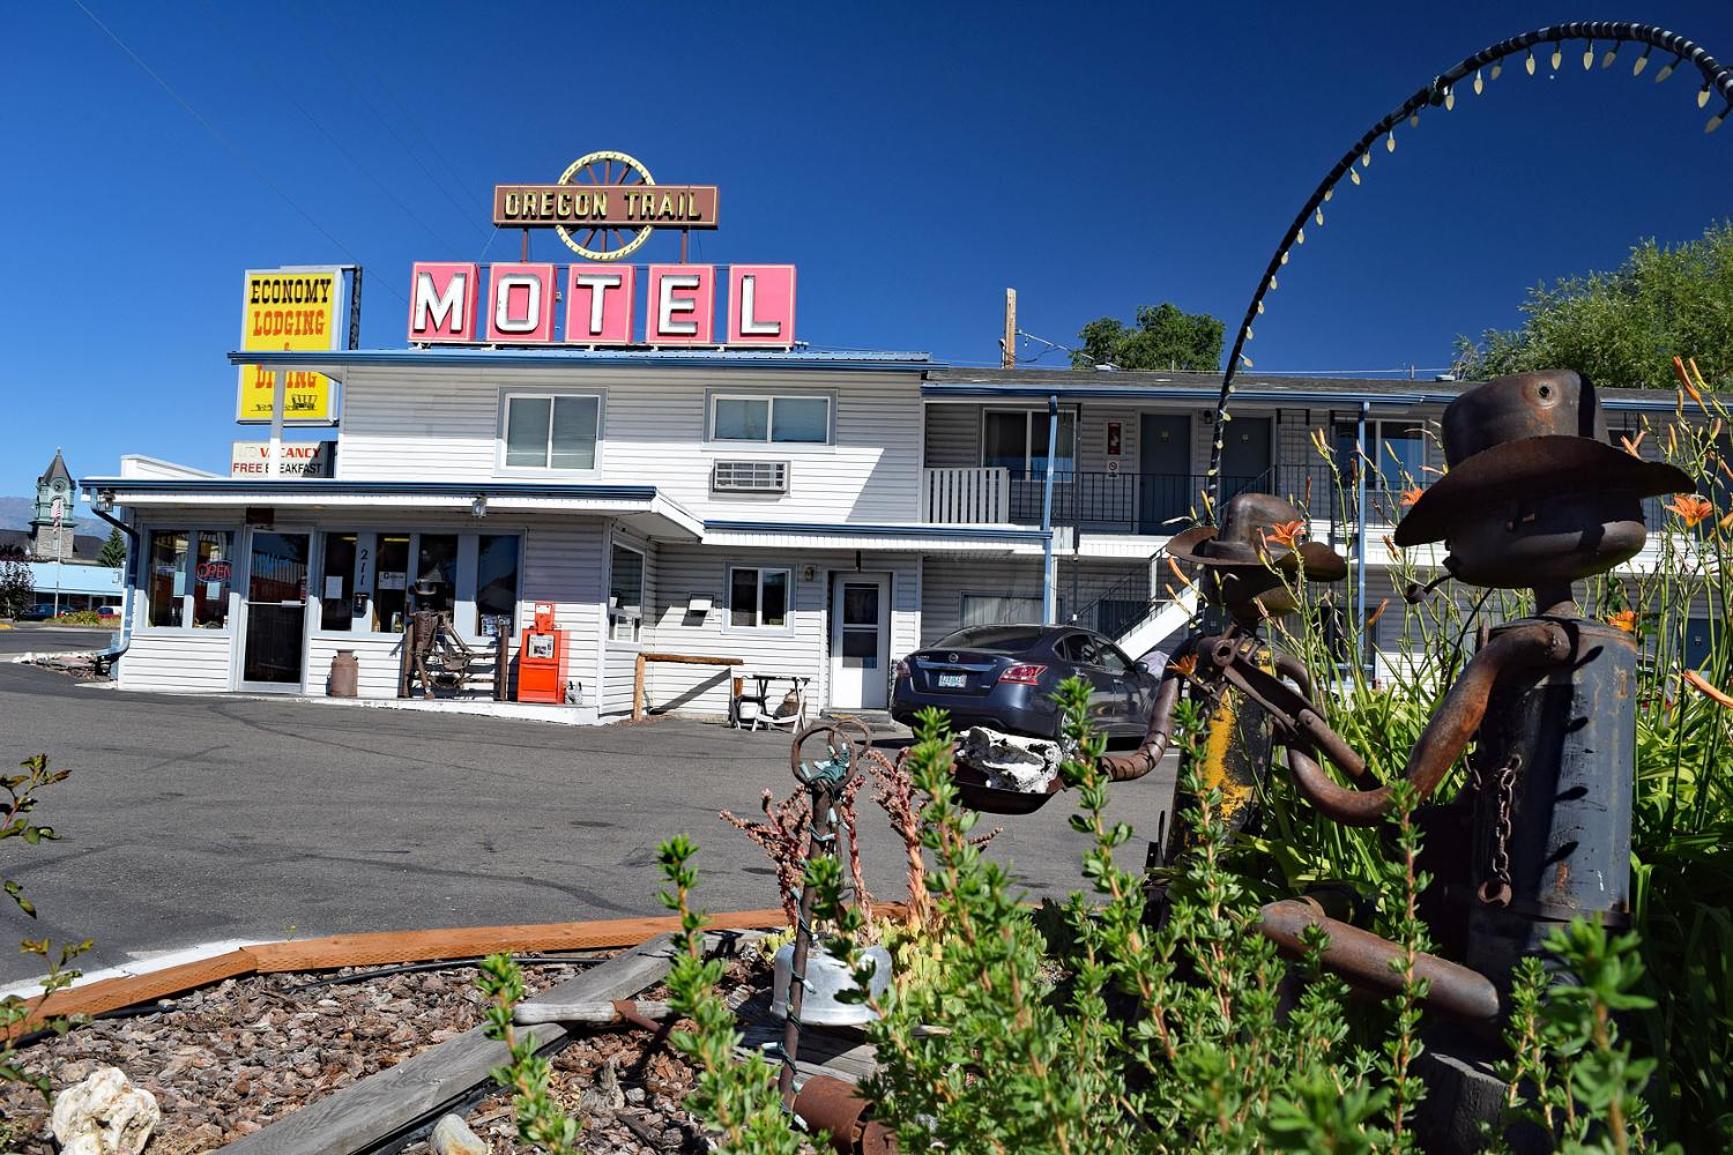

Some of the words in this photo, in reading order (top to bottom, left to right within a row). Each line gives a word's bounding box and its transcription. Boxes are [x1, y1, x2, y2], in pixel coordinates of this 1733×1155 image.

[505, 191, 608, 218] OREGON
[625, 191, 702, 218] TRAIL
[251, 278, 331, 304] ECONOMY
[413, 272, 782, 335] MOTEL
[253, 310, 325, 336] LODGING
[255, 363, 317, 389] DIING
[260, 447, 322, 459] VANCY
[233, 462, 263, 474] FREE
[265, 462, 322, 474] EAKFAST
[196, 562, 231, 579] OPEN
